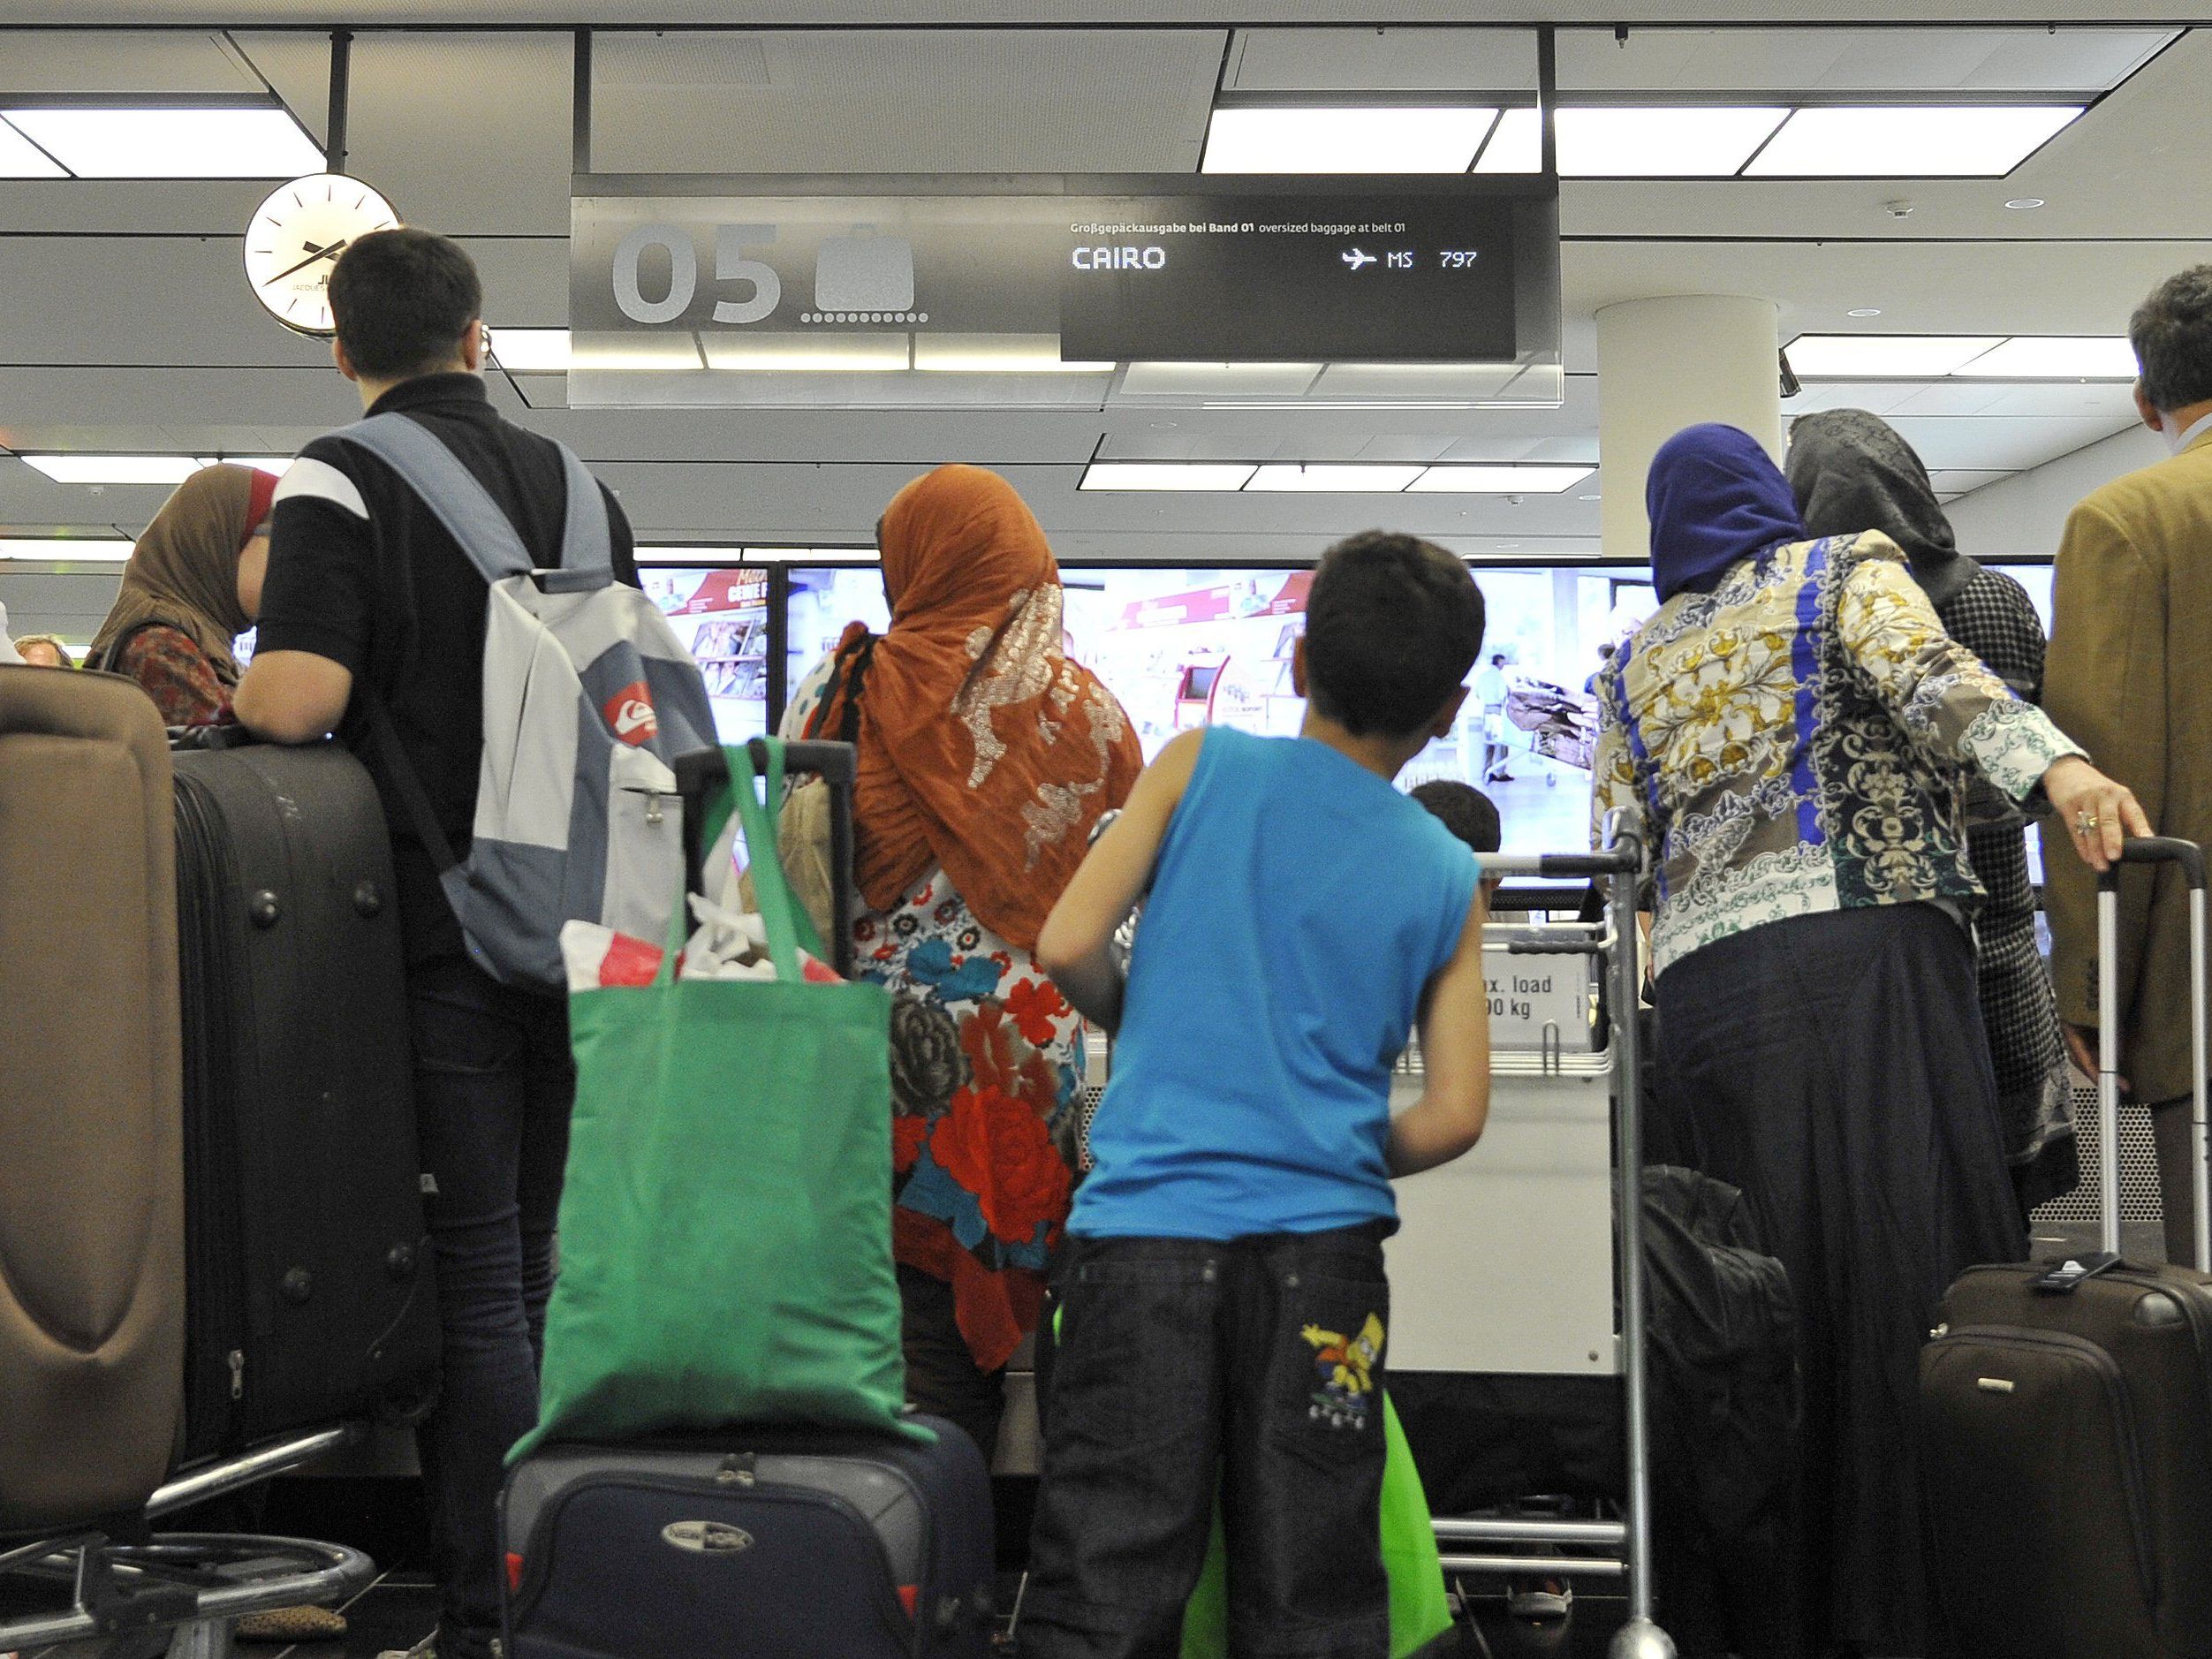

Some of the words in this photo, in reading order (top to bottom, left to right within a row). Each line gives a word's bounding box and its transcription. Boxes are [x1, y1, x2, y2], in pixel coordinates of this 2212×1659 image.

[1070, 223, 1186, 235] Großgepäckausgabe
[1189, 223, 1206, 232] bei
[1208, 223, 1238, 232] Band
[1241, 223, 1254, 232] 01
[1259, 223, 1308, 232] oversized
[1311, 223, 1356, 235] baggage
[1358, 223, 1369, 232] at
[1371, 223, 1392, 232] belt
[1394, 223, 1405, 232] 01
[1072, 246, 1166, 269] CAIRO
[1388, 252, 1413, 269] MS
[1440, 252, 1477, 268] 797
[612, 222, 782, 324] 05
[1513, 975, 1551, 993] load
[1511, 998, 1530, 1019] kg
